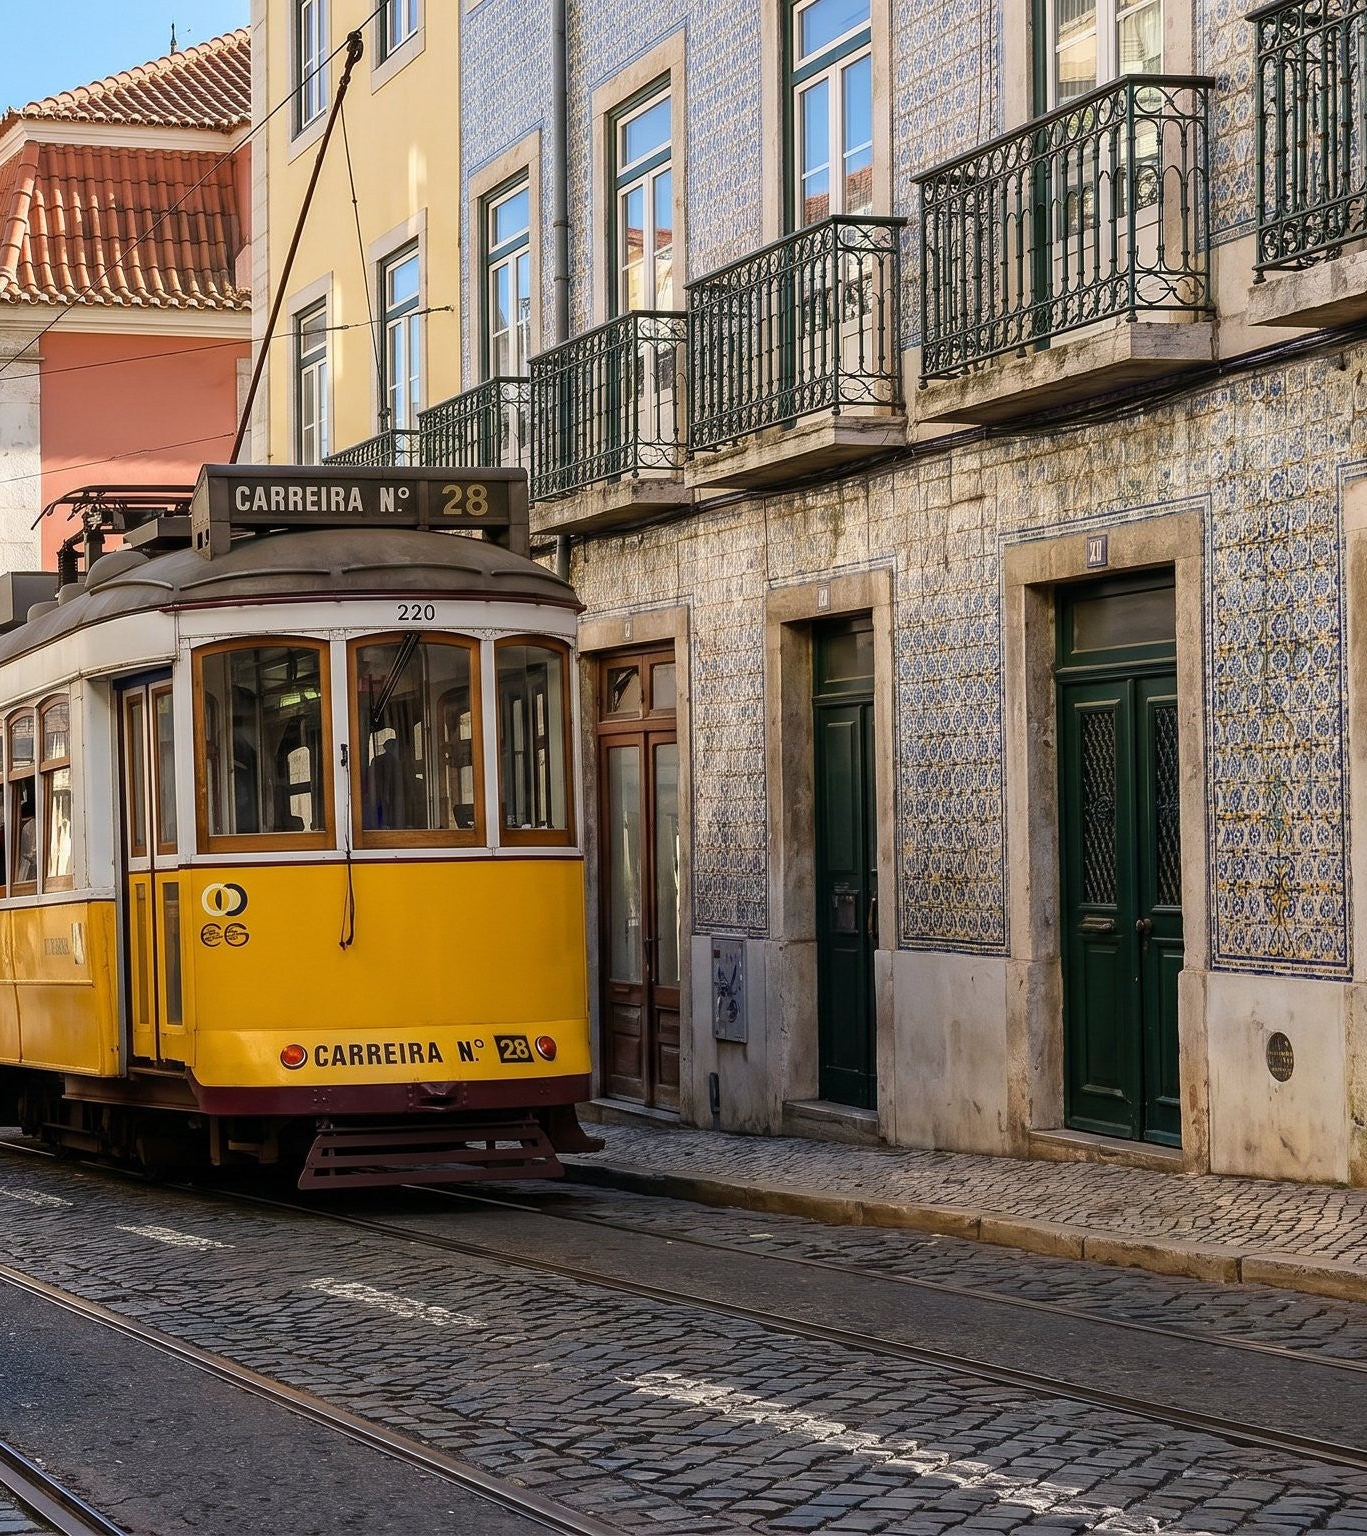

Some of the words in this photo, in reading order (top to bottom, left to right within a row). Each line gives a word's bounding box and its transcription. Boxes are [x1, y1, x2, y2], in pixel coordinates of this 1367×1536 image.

[235, 485, 364, 512] CARREIRA
[441, 484, 489, 516] 28
[397, 604, 436, 622] 220
[314, 1042, 444, 1067] CARREIRA
[499, 1038, 529, 1060] 28
